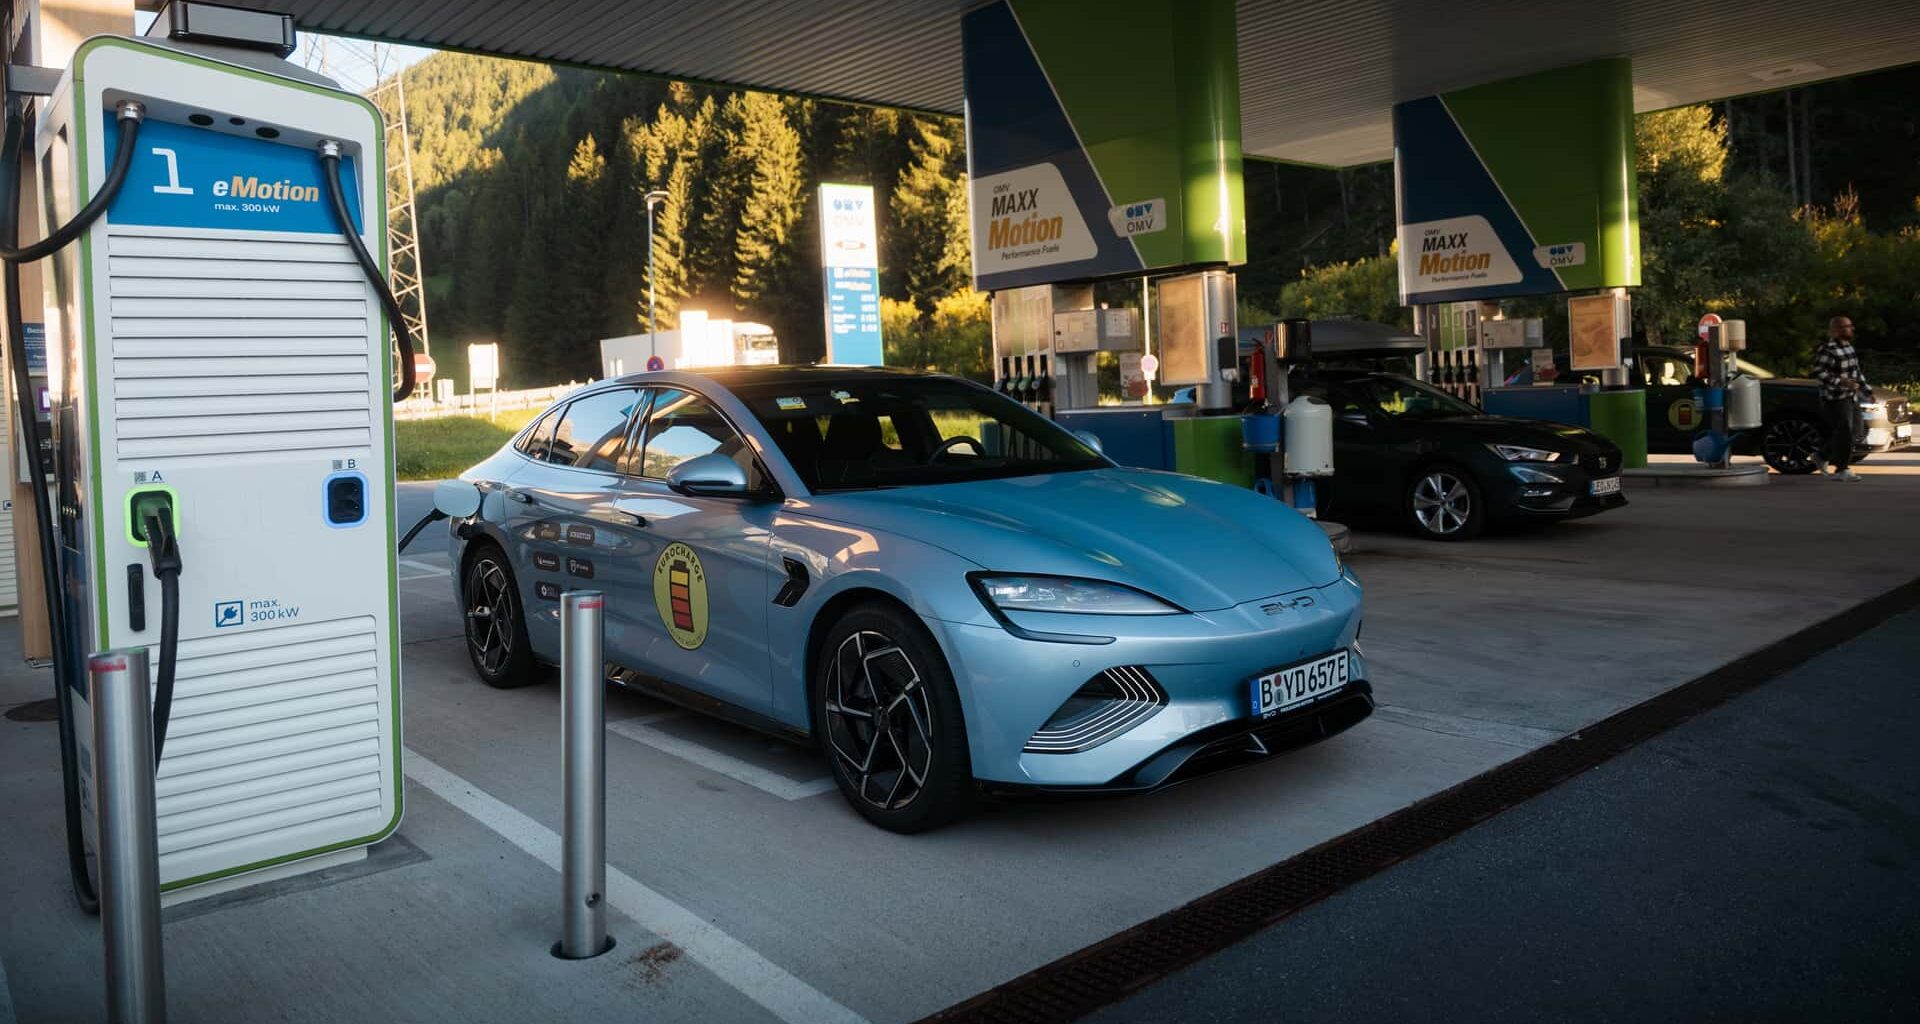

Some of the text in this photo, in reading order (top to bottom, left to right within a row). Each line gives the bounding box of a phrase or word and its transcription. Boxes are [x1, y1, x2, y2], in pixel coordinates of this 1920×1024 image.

[152, 147, 194, 195] 1
[212, 175, 319, 202] eMotion
[993, 183, 1010, 194] OMV
[214, 203, 280, 213] max. 300 kW
[991, 187, 1039, 218] MAXX
[988, 210, 1064, 251] Motion
[1127, 219, 1153, 233] OMV
[1424, 228, 1441, 237] OMV
[1422, 231, 1468, 253] MAXX
[1001, 247, 1041, 261] Performance
[1551, 256, 1575, 266] OMV
[1419, 248, 1491, 277] Motion
[347, 459, 356, 469] B
[152, 470, 162, 482] A
[658, 546, 704, 583] EUROCHARGE
[250, 600, 281, 610] max.
[1260, 596, 1314, 616] BYD
[250, 607, 299, 622] 300 kW
